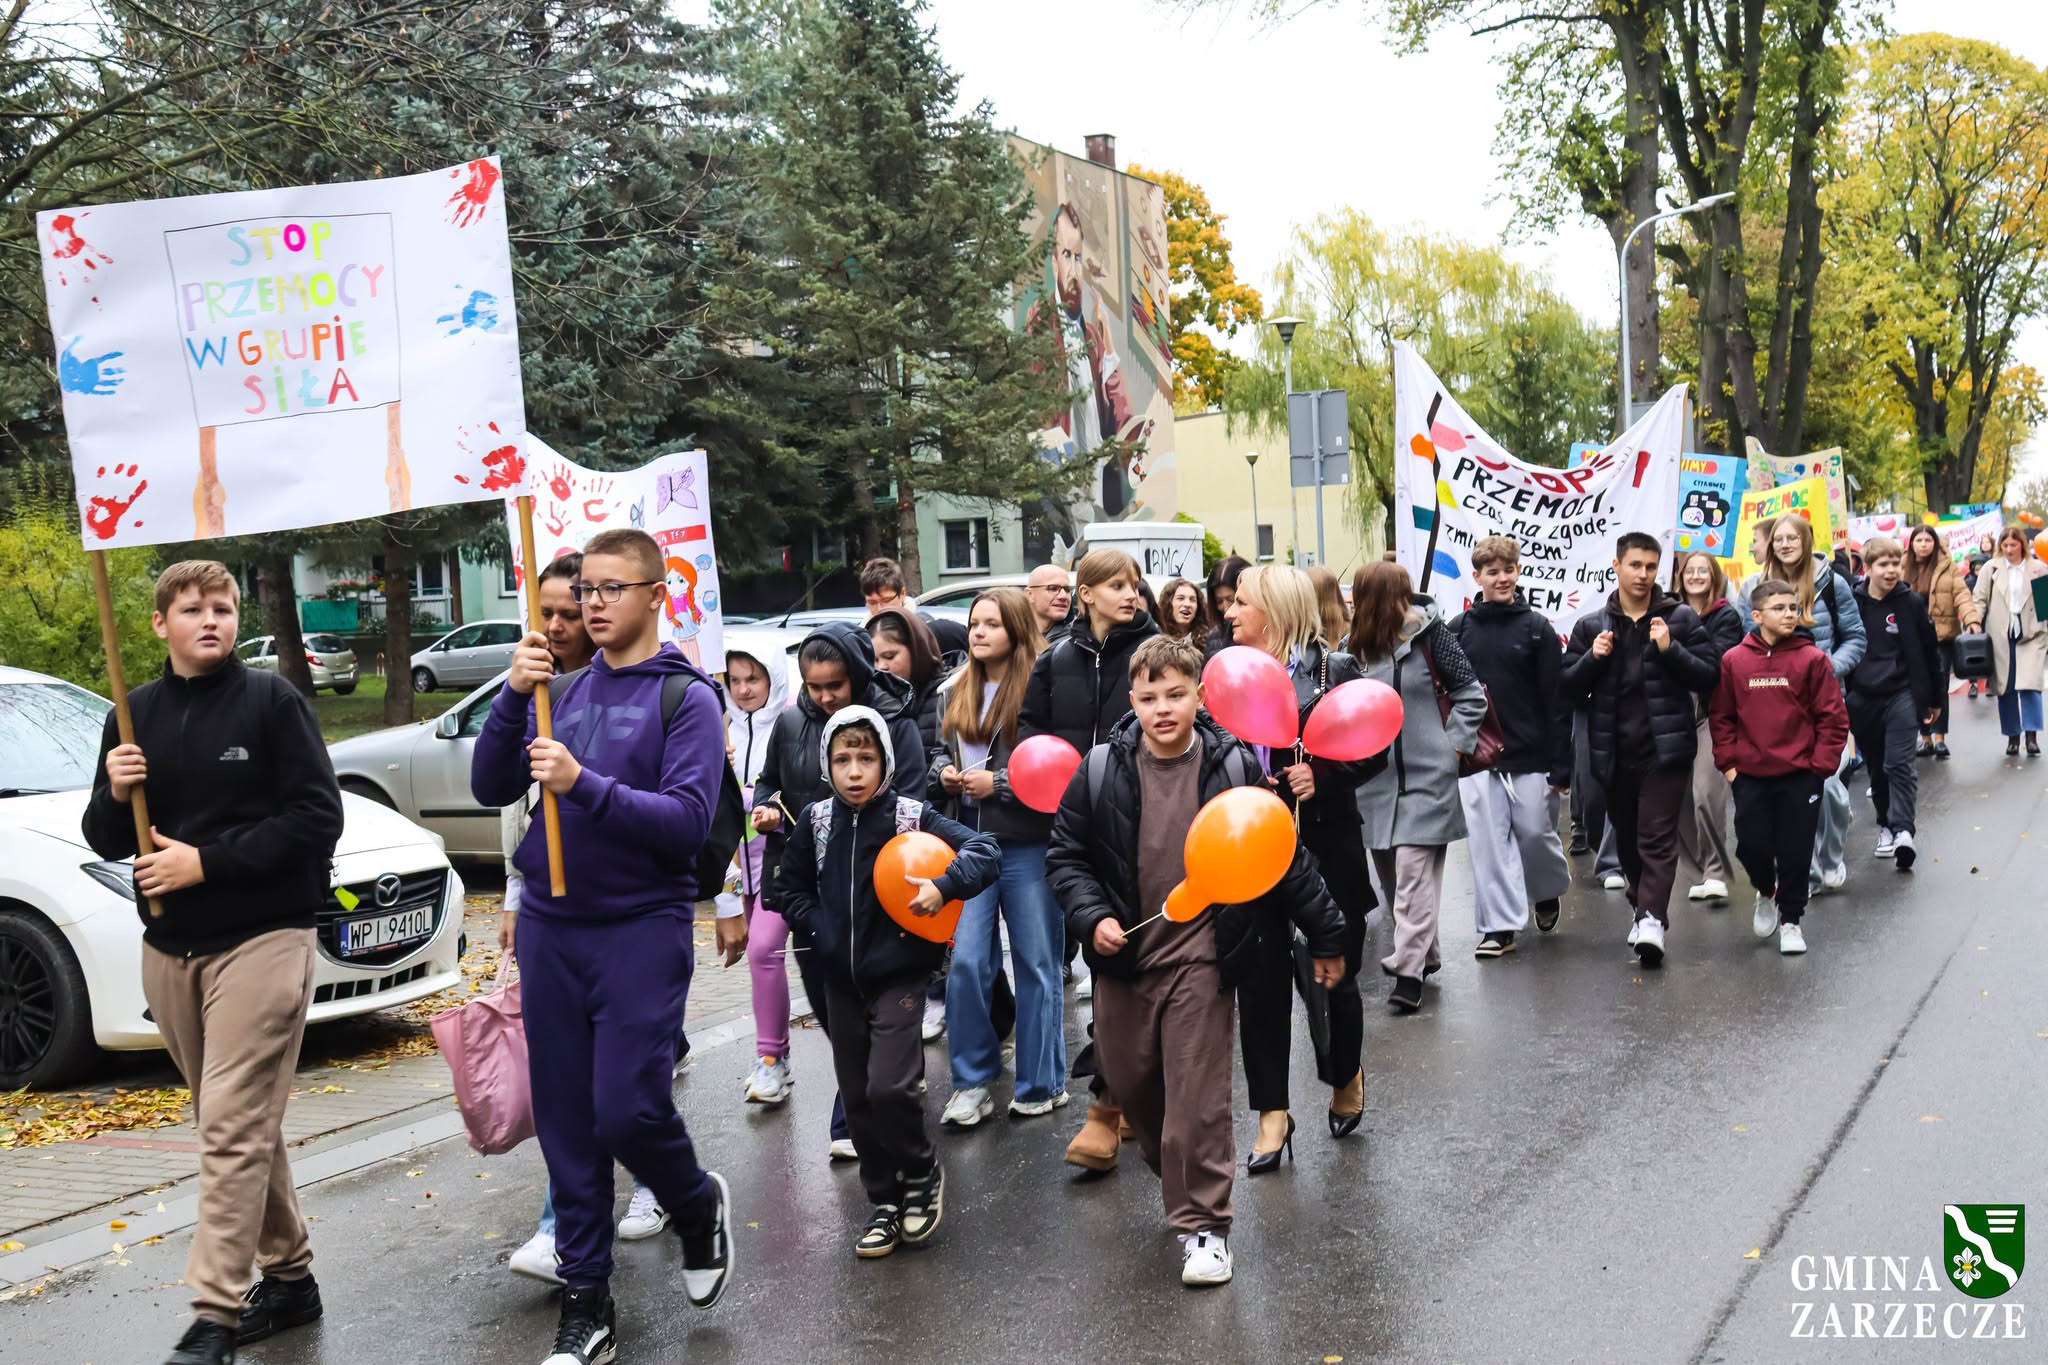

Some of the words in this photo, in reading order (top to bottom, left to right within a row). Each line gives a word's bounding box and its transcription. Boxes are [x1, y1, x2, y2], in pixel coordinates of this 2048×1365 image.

[228, 222, 331, 267] STOP
[182, 264, 384, 331] PRZEMOCY
[186, 335, 227, 370] W
[1512, 518, 1541, 537] na
[389, 909, 430, 941] 9410L
